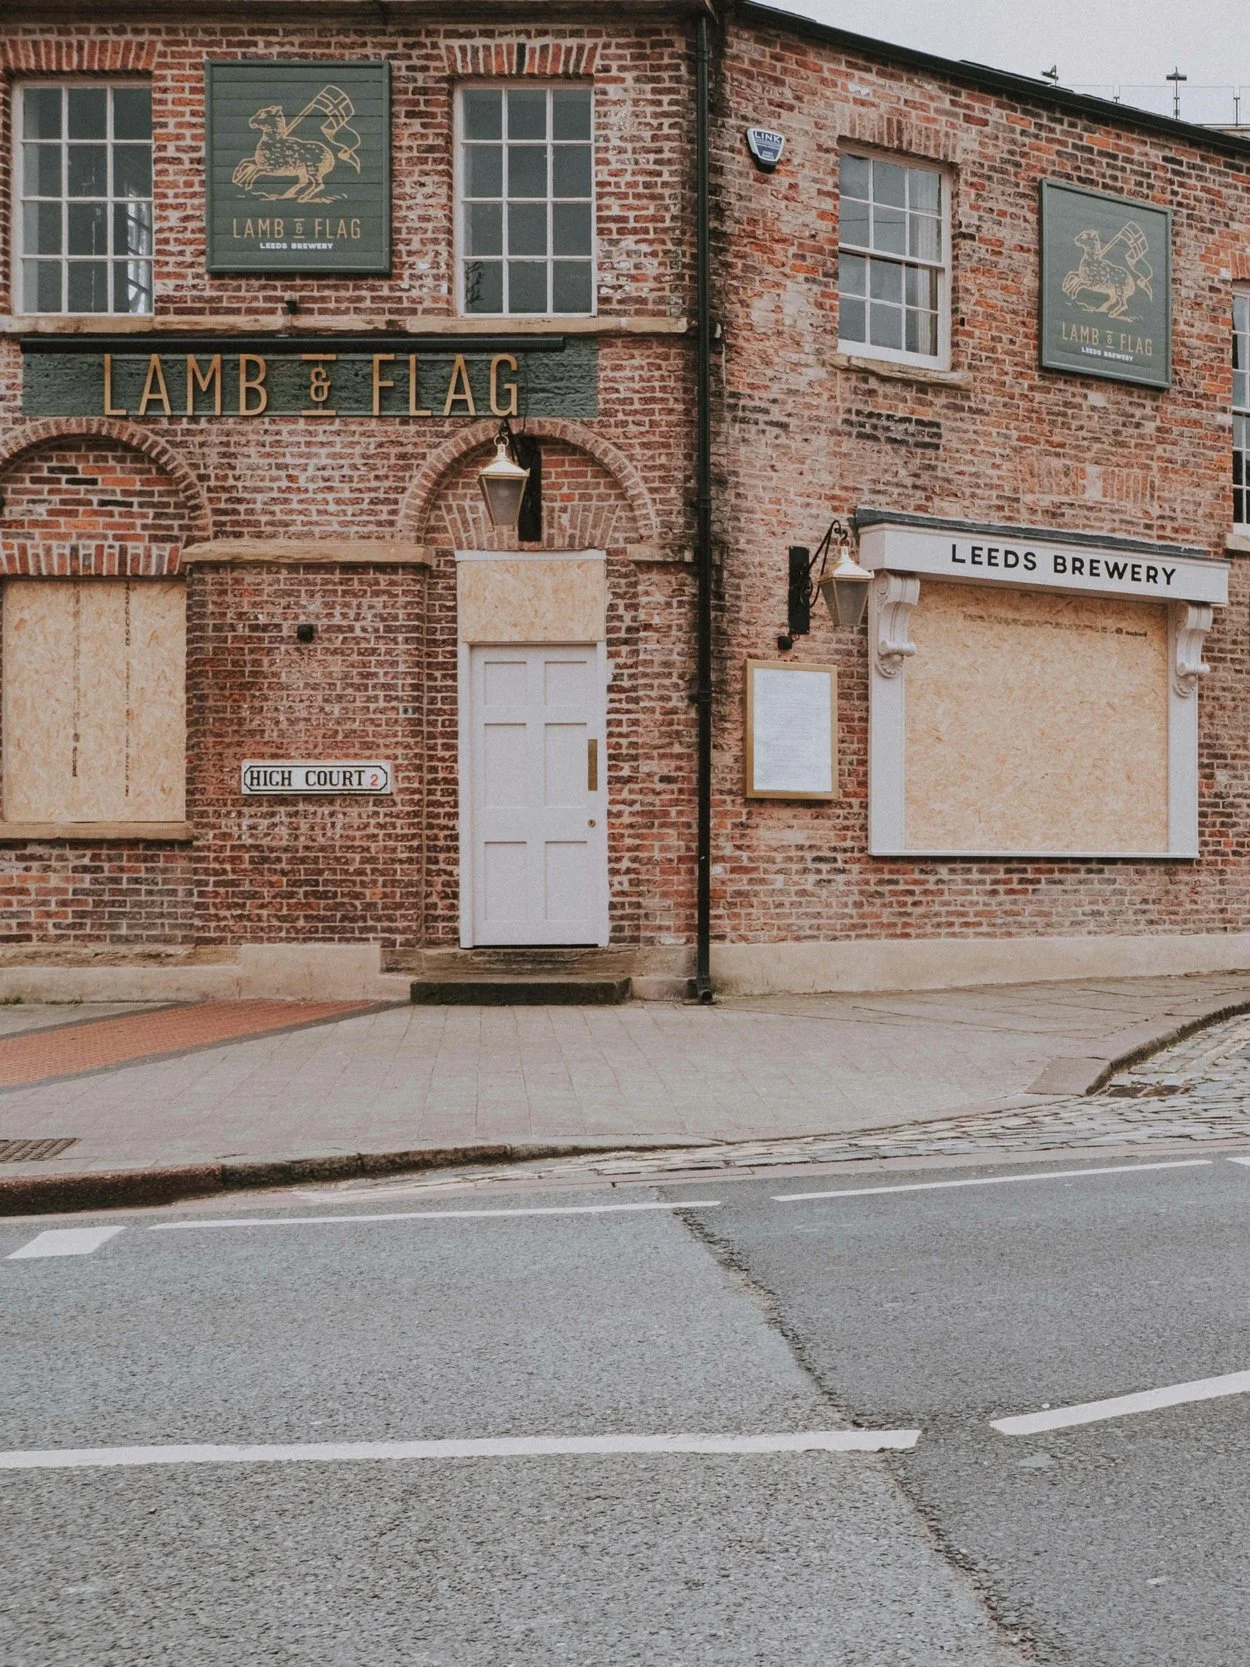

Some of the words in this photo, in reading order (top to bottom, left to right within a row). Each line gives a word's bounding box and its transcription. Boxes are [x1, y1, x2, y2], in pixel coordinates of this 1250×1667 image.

[754, 131, 780, 143] LINK
[233, 218, 284, 239] LAMB
[315, 218, 361, 239] FLAG
[260, 242, 288, 250] LEEDS
[291, 242, 334, 250] BREWERY
[1062, 321, 1100, 346] LAMB
[1120, 333, 1153, 357] FLAG
[1081, 346, 1102, 356] LEEDS
[1103, 351, 1134, 362] BREWERY
[104, 354, 268, 417] LAMB
[373, 354, 518, 417] FLAG
[951, 543, 1037, 571] LEEDS
[1053, 554, 1177, 586] BREWERY
[250, 770, 292, 786] HIGH
[305, 770, 365, 787] COURT
[370, 773, 379, 786] 2
